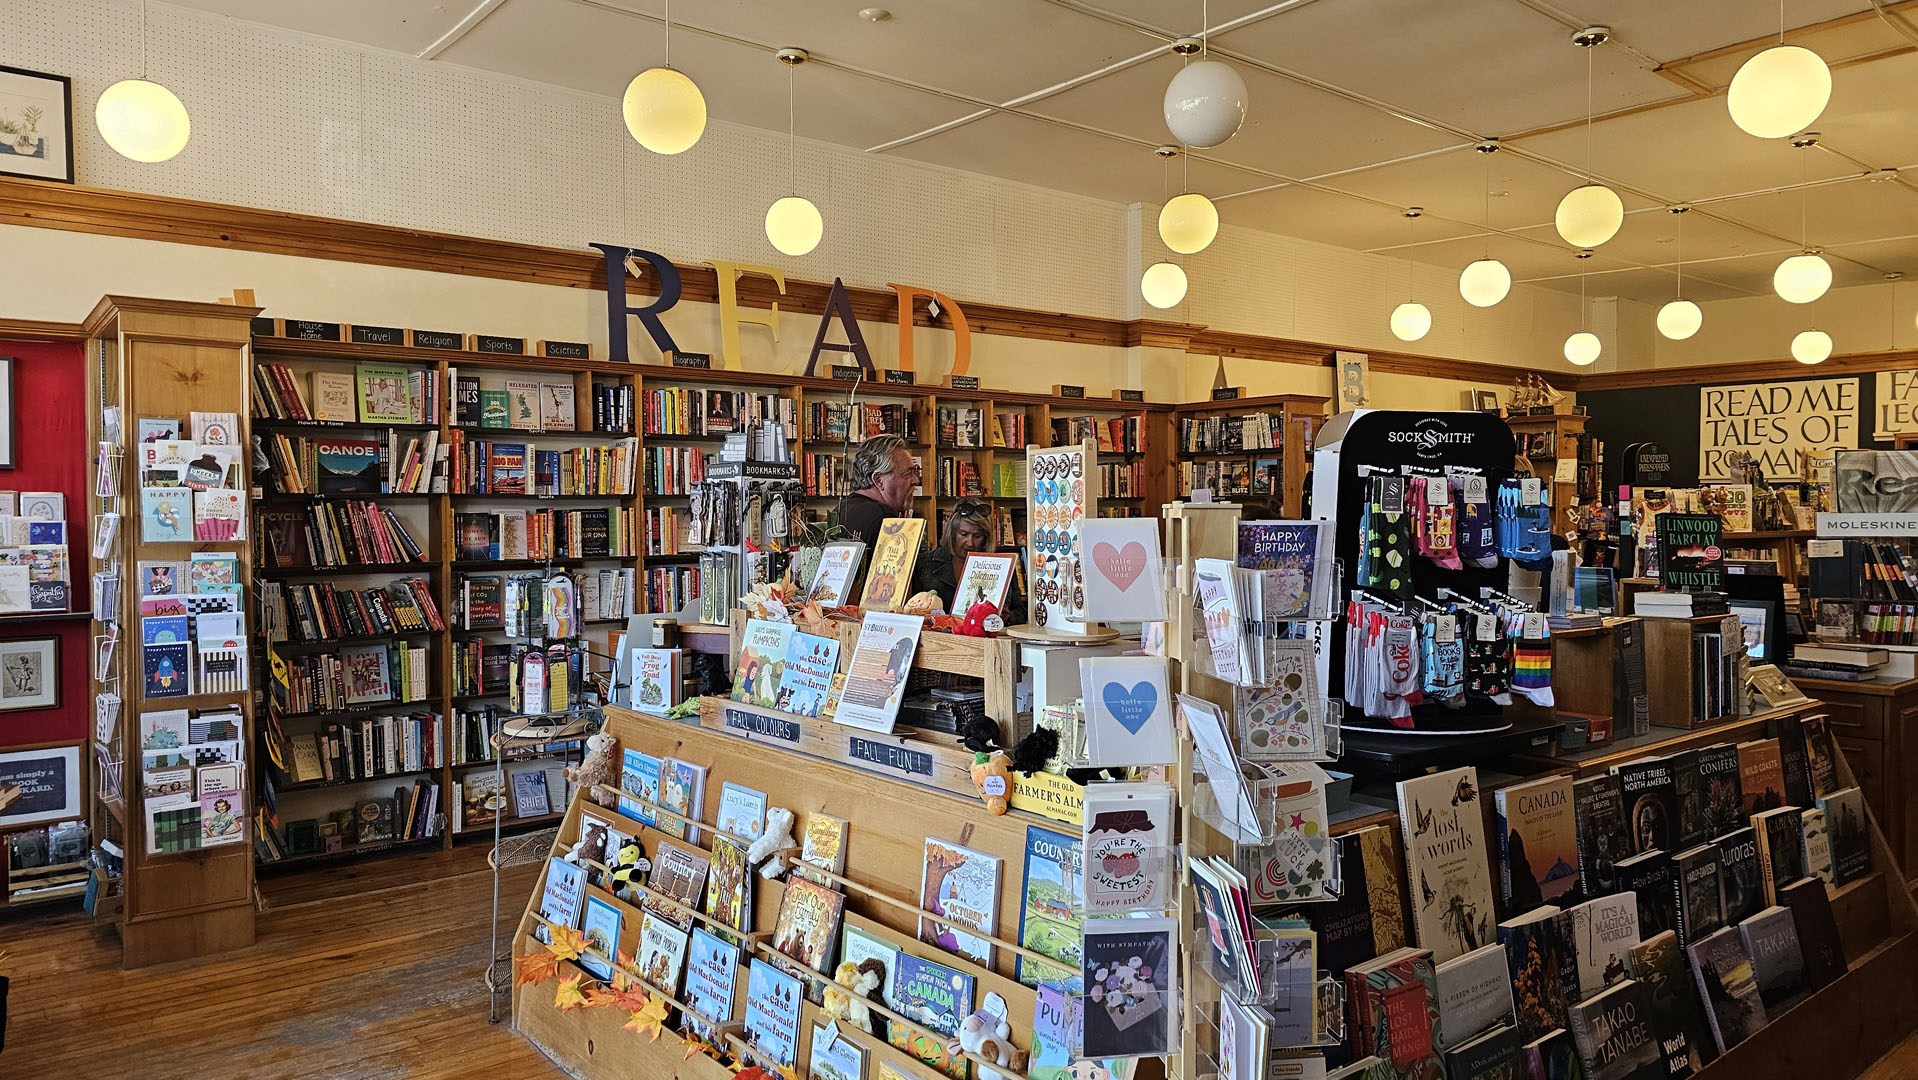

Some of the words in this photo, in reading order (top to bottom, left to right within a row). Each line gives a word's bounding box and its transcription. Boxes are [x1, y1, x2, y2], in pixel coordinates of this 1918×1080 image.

[587, 242, 971, 382] READ
[298, 321, 324, 331] House
[300, 332, 323, 340] Home
[359, 329, 392, 341] Travel
[418, 333, 453, 347] Religion
[485, 339, 513, 351] Sports
[550, 345, 581, 356] Science
[673, 354, 707, 368] Biography
[1706, 387, 1792, 417] READ
[1796, 383, 1855, 413] ME
[1706, 416, 1789, 446] TALES
[1801, 414, 1852, 443] OF
[319, 445, 374, 457] CANOE
[492, 455, 508, 465] BIG
[508, 456, 522, 466] FAN
[708, 466, 733, 476] BOOKMARKS
[746, 466, 785, 476] BOOKMARKS
[1666, 520, 1718, 532] LINWOOD
[1827, 521, 1917, 529] MOLESKINE
[1261, 531, 1301, 542] HAPPY
[1669, 533, 1716, 546] BARCLAY
[1254, 541, 1305, 553] BIRTHDAY
[972, 559, 1002, 571] Delicious
[1668, 572, 1721, 586] WHISTLE
[154, 602, 183, 616] big
[372, 596, 388, 625] Canada
[752, 634, 781, 649] PUMPKINS
[807, 653, 827, 667] case
[1437, 647, 1461, 657] BOOKS
[641, 661, 660, 670] Frog
[794, 663, 830, 680] MacDonald
[1392, 644, 1411, 684] Coke
[641, 670, 660, 679] Toad
[346, 682, 389, 699] JAPAN
[807, 678, 827, 692] farm
[731, 710, 750, 731] FALL
[755, 714, 791, 739] COLOURS
[857, 739, 881, 763] FALL
[16, 770, 47, 779] simply
[1699, 756, 1738, 776] CONIFERS
[1755, 759, 1778, 774] COASTS
[1623, 770, 1646, 783] NATIVE
[1646, 767, 1666, 777] TRIBES
[1624, 780, 1646, 792] NORTH
[1646, 775, 1672, 788] AMERICA
[1047, 779, 1062, 789] THE
[1061, 782, 1075, 793] OLD
[519, 795, 546, 809] SHIFT
[1013, 781, 1061, 804] FARMER'S
[1063, 796, 1083, 810] ALM
[1518, 788, 1567, 815] CANADA
[1432, 808, 1460, 839] lost
[1094, 838, 1126, 861] YOU'RE
[1129, 838, 1147, 855] THE
[1290, 831, 1310, 853] LITTLE
[1426, 826, 1473, 860] words
[1720, 839, 1755, 867] Auroras
[662, 851, 697, 883] Country
[1763, 852, 1773, 882] CABINS
[560, 880, 573, 894] case
[1092, 870, 1145, 892] SWEETEST
[1095, 898, 1121, 907] HAPPY
[1122, 878, 1154, 906] BIRTHDAY
[559, 903, 572, 918] farm
[810, 893, 827, 912] Our
[794, 902, 820, 923] Family
[949, 903, 983, 925] OCTOBER
[1601, 905, 1618, 918] IT'S
[1326, 930, 1342, 943] MAP
[1352, 921, 1370, 936] MAP
[1595, 915, 1636, 935] MAGICAL
[1600, 926, 1633, 945] WORLD
[1755, 927, 1798, 958] TAKAYA
[852, 938, 869, 952] Good
[867, 944, 890, 963] Morning
[707, 960, 726, 976] case
[697, 965, 730, 992] MacDonald
[709, 988, 728, 1006] farm
[769, 994, 789, 1012] case
[907, 980, 956, 1012] CANADA
[757, 1000, 794, 1030] MacDonald
[1387, 1001, 1406, 1015] THE
[1389, 1015, 1413, 1030] LOST
[1592, 1001, 1636, 1036] TAKAO
[772, 1024, 792, 1045] farm
[1391, 1027, 1422, 1044] HAIDA
[1598, 1020, 1650, 1065] TANABE
[1663, 1031, 1686, 1054] World
[1393, 1038, 1427, 1059] MANGA
[1669, 1053, 1689, 1074] Atlas
